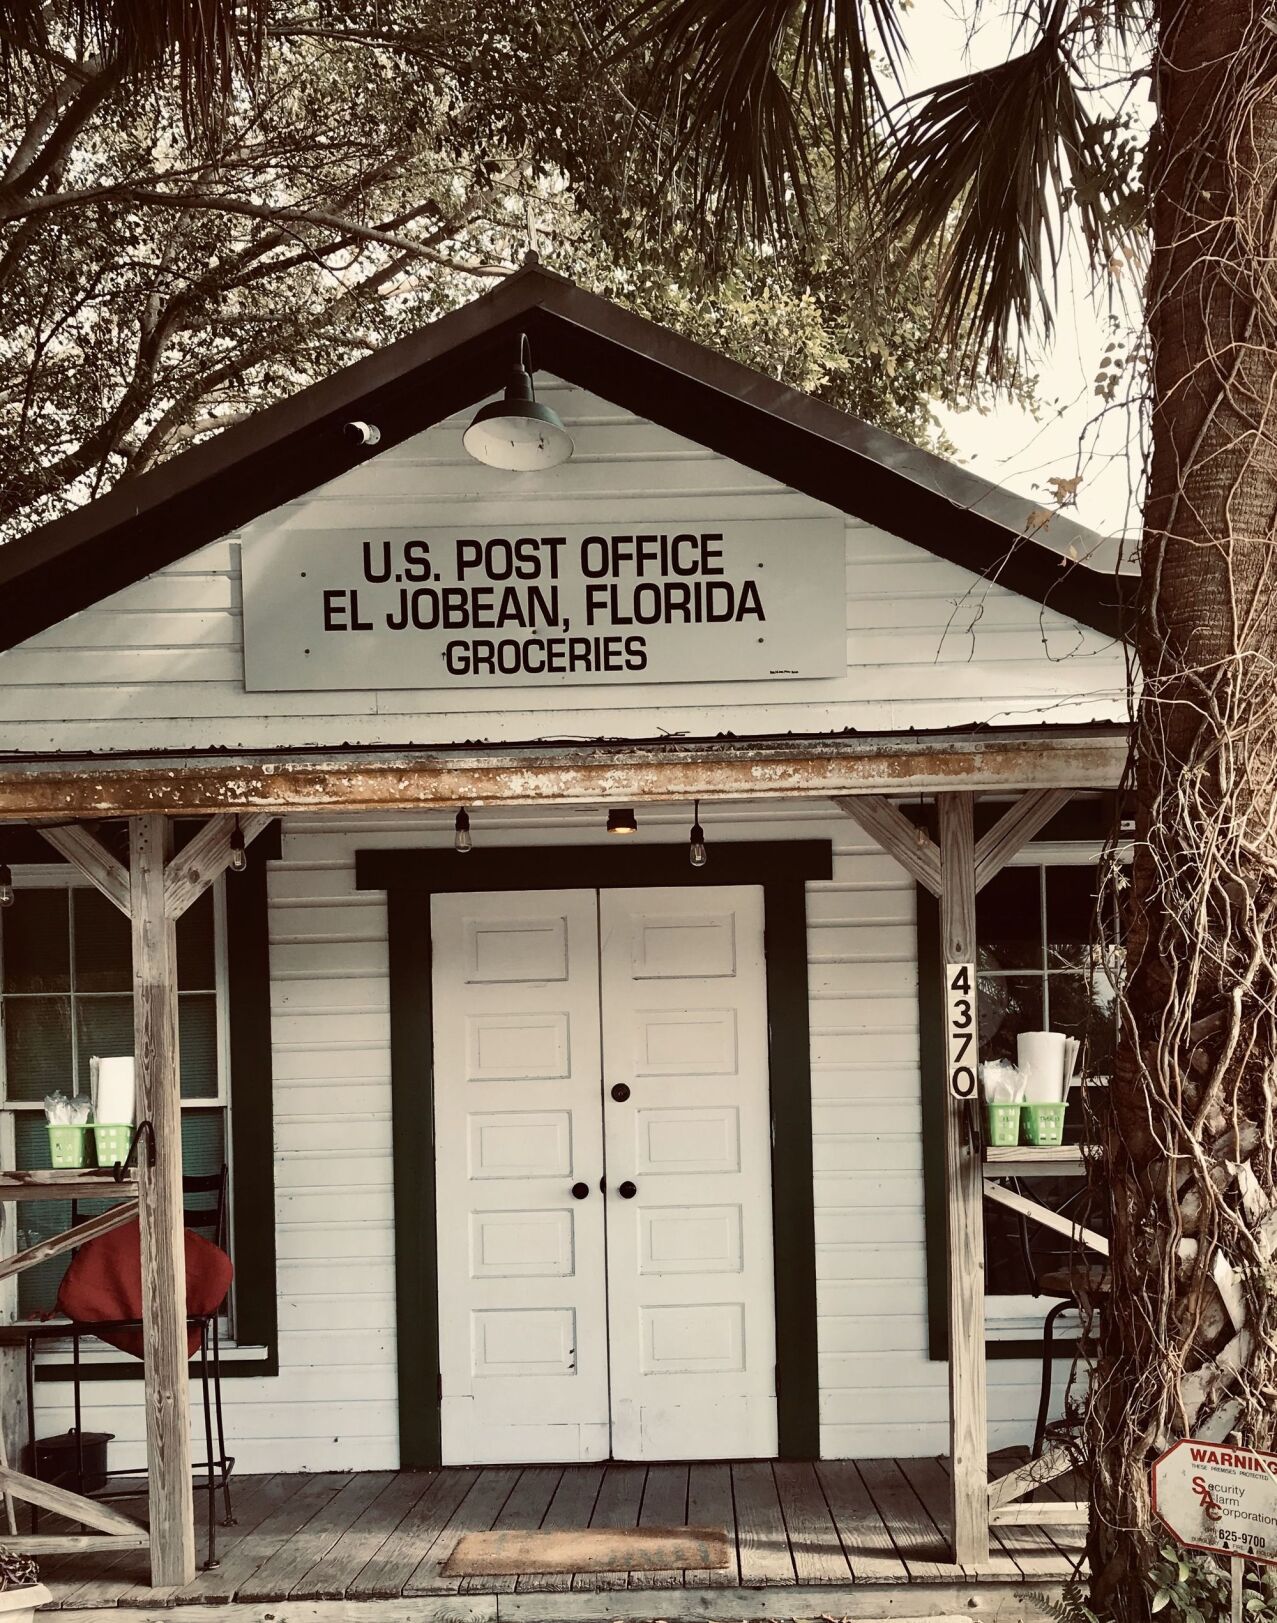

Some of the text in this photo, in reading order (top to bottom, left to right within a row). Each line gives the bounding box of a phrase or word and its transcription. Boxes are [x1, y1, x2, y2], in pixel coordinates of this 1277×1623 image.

[363, 533, 724, 583] U.S. POST OFFICE
[323, 580, 765, 634] EL JOBEAN, FLORIDA
[445, 636, 648, 676] GROCERIES
[951, 965, 975, 1098] 4370
[1190, 1447, 1277, 1475] WARNING
[1218, 1528, 1266, 1549] 625-9700
